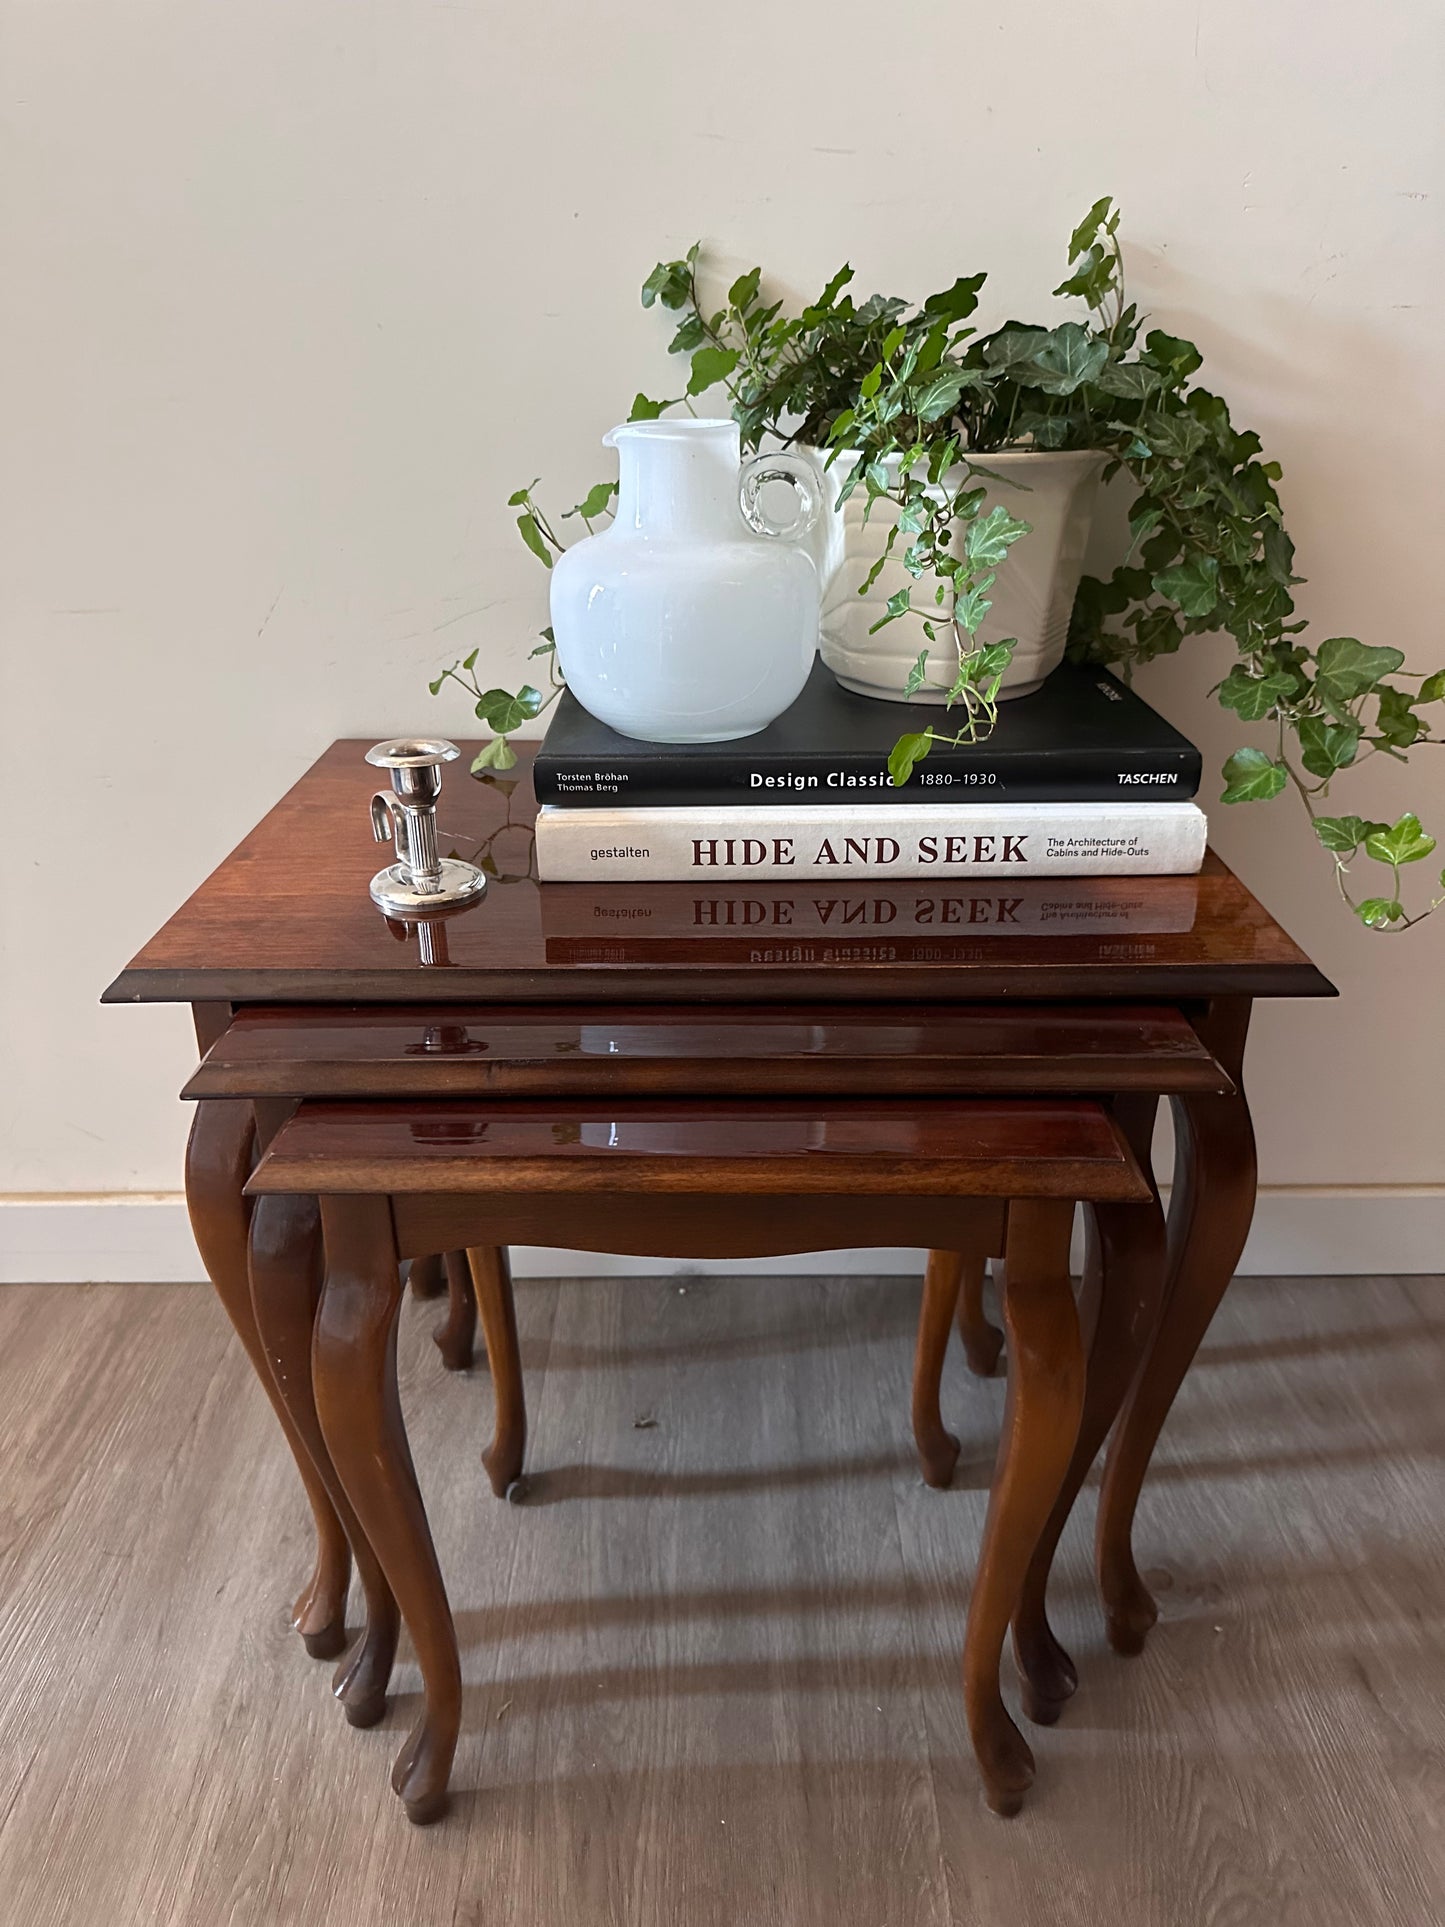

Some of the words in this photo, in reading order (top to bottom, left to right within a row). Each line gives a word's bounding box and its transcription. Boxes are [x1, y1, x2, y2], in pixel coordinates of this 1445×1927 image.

[555, 772, 592, 782] Torsten
[750, 772, 818, 790] Design
[826, 771, 895, 787] Classic
[1117, 773, 1178, 785] TASCHEN
[556, 783, 594, 792] Thomas
[596, 783, 619, 793] Berg
[1047, 837, 1065, 847] The
[1066, 837, 1126, 847] Architecture
[1127, 836, 1139, 846] of
[590, 846, 650, 861] gestalten
[691, 838, 796, 867] HIDE
[812, 836, 901, 865] AND
[918, 834, 1029, 864] SEEK
[1046, 847, 1079, 858] Cabins
[1081, 847, 1099, 857] and
[1100, 847, 1149, 857] Hide-Outs
